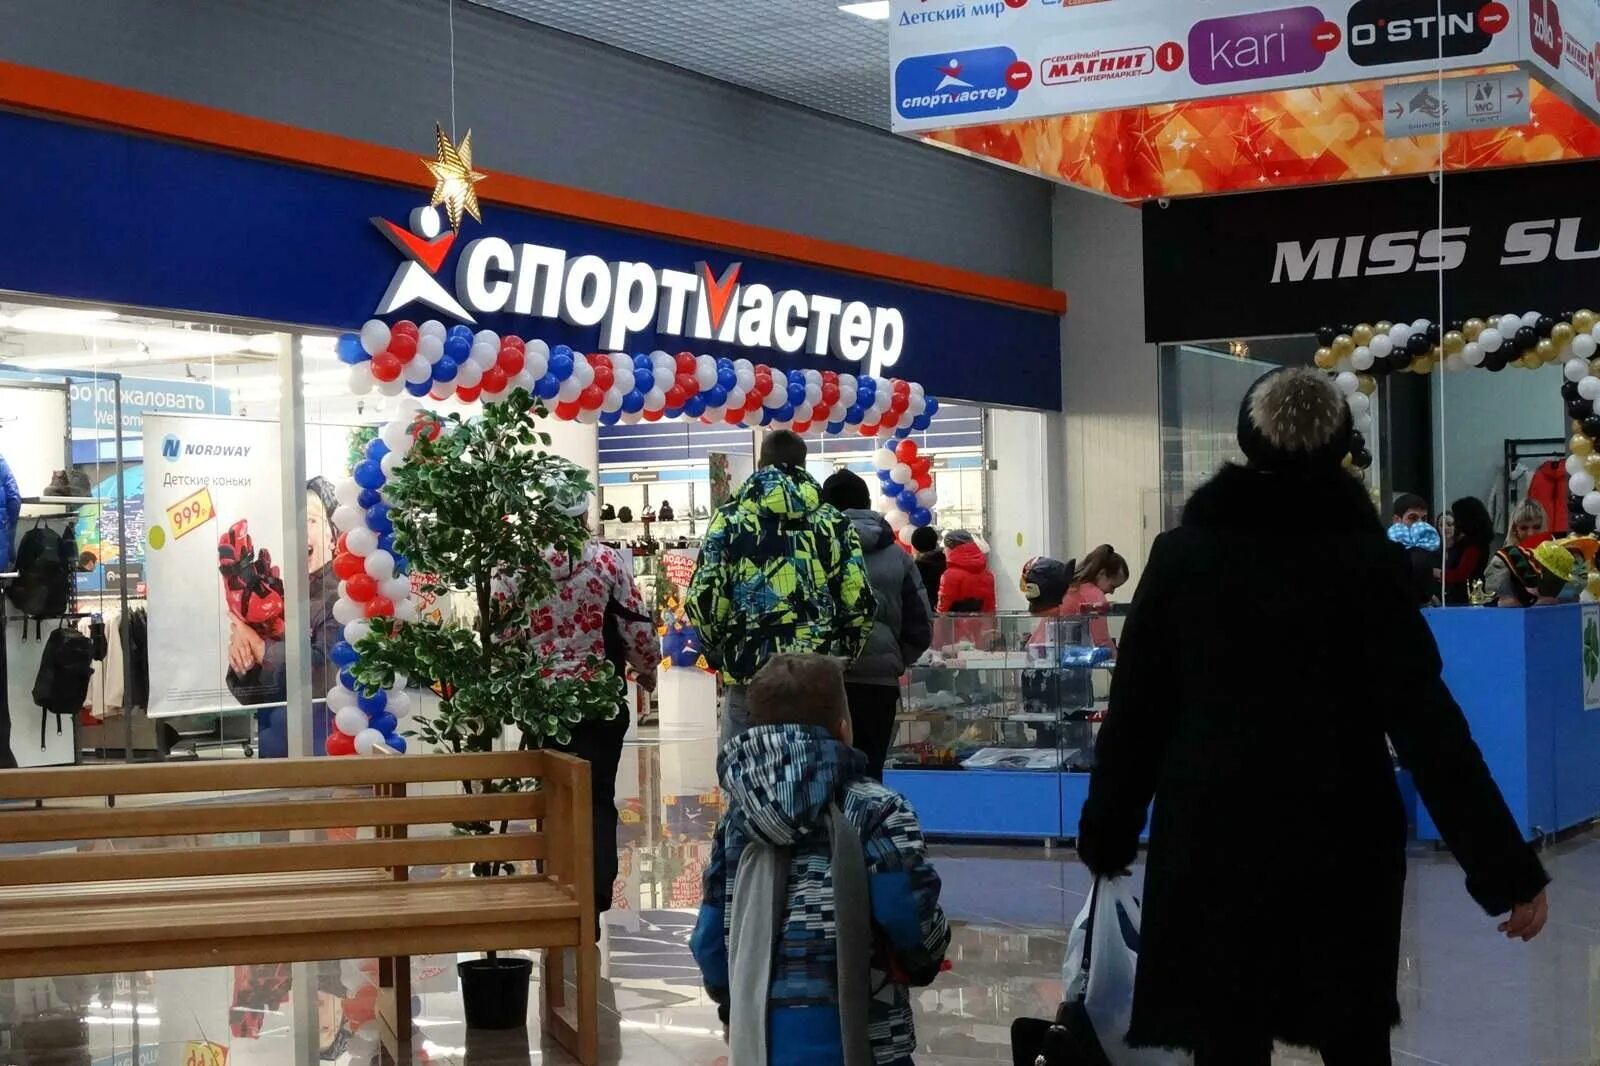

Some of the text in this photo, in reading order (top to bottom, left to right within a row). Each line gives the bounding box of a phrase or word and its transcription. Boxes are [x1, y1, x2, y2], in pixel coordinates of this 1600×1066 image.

[898, 3, 1005, 26] Детский мир
[1210, 24, 1286, 71] kari
[1051, 50, 1100, 63] СЕМЕЙНЫЙ
[1048, 54, 1146, 78] МАГНИТ
[1079, 70, 1142, 83] ГИПЕРМАРКЕТ
[1474, 102, 1494, 113] WC
[1271, 226, 1471, 284] MISS
[94, 409, 143, 426] Welom
[185, 443, 251, 457] NORDWAY
[163, 472, 252, 488] Детские коньки
